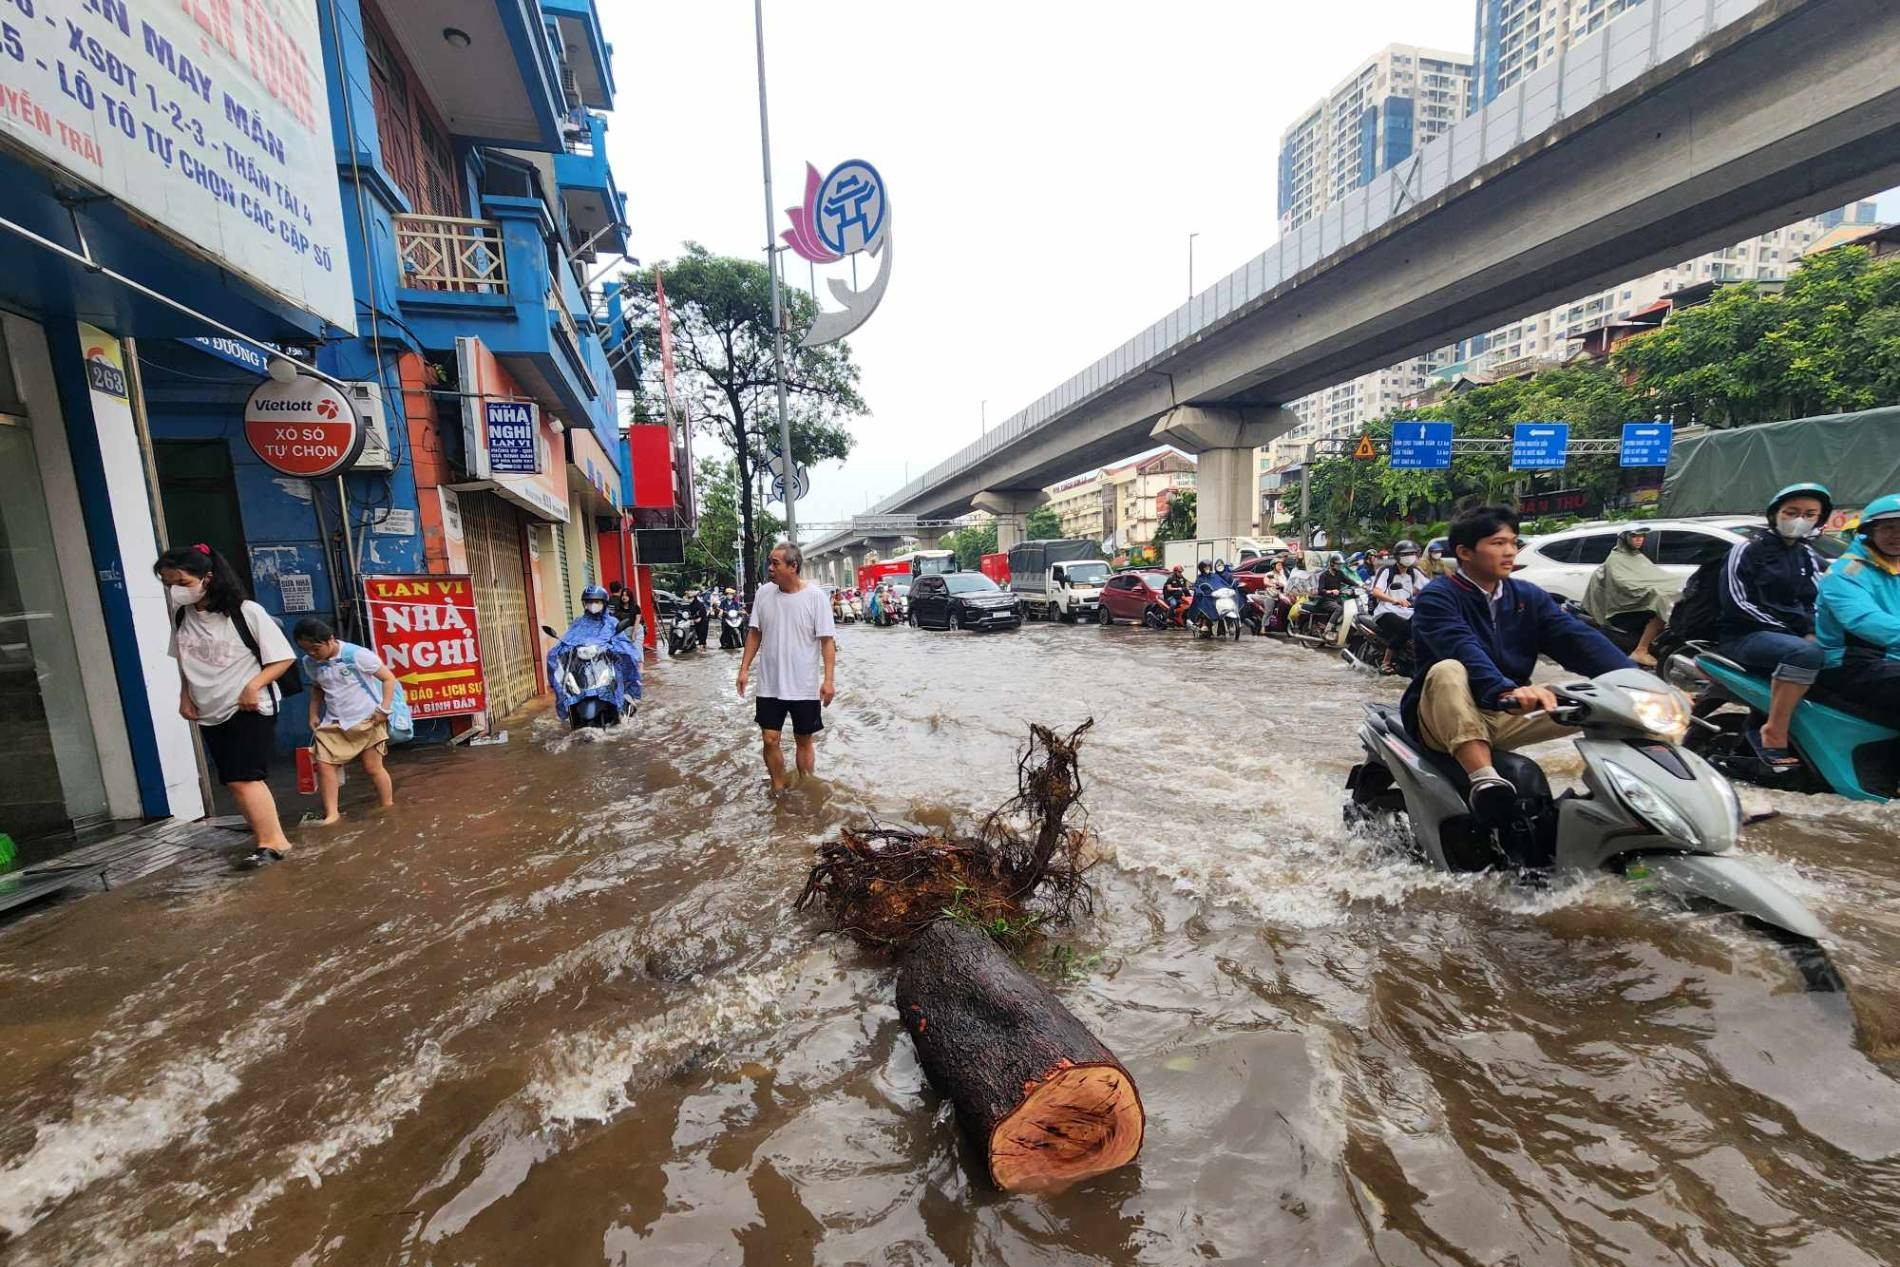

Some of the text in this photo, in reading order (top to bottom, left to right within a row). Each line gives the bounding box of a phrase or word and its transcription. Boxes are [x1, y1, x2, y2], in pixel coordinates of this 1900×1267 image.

[142, 19, 212, 104] MAY
[223, 91, 285, 165] MẮN
[65, 16, 137, 97] XSĐT
[145, 83, 205, 147] 1-2-3
[222, 141, 271, 198] THẦN
[274, 181, 300, 218] TÀI
[303, 204, 313, 227] 4
[56, 118, 104, 168] TRÃI
[56, 59, 95, 110] LÔ
[101, 91, 137, 139] TÔ
[141, 121, 174, 169] TỰ
[179, 149, 236, 208] CHỌN
[240, 192, 275, 234] CÁC
[279, 219, 310, 254] CẶP
[313, 243, 332, 272] SỐ
[92, 366, 124, 394] 263
[255, 400, 313, 411] Vietlott
[489, 406, 529, 422] NHÀ
[489, 422, 532, 439] NGHỈ
[265, 443, 339, 460] TỰ CHỌN
[492, 439, 531, 448] LAN VI
[376, 581, 465, 597] LAN VI
[382, 596, 468, 634] NHÀ
[381, 627, 479, 670] NGHỈ
[441, 684, 467, 699] LỊCH
[467, 681, 483, 696] SỰ
[423, 700, 451, 713] BÌNH
[453, 697, 476, 710] DÂN
